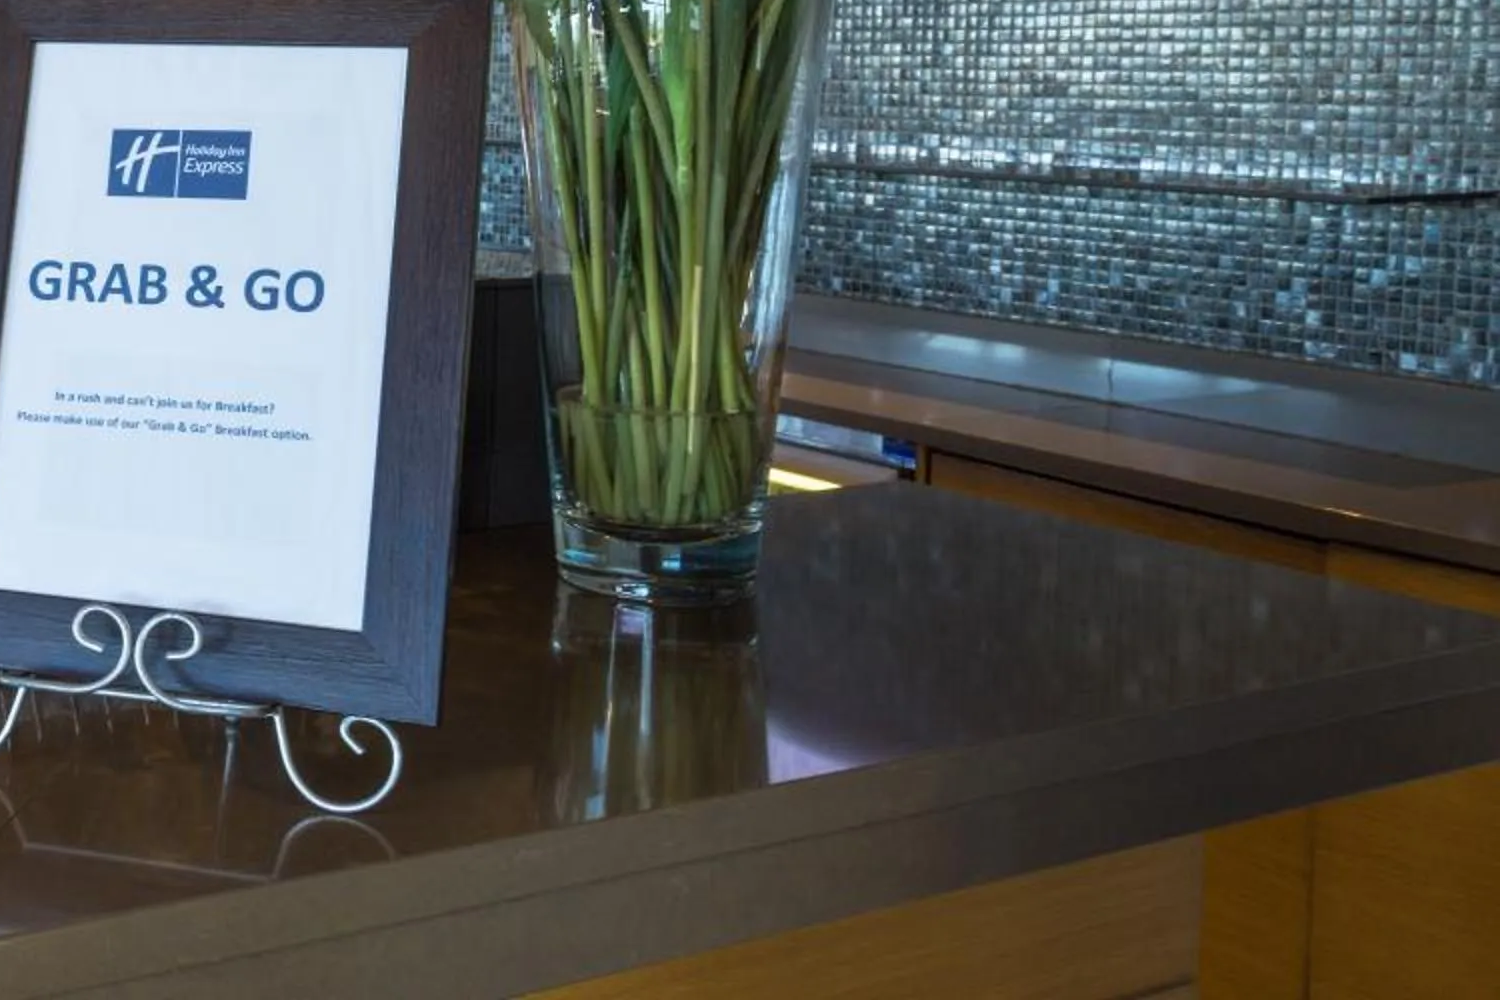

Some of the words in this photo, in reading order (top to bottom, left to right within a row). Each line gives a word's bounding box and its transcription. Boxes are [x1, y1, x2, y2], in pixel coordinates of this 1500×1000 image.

[185, 143, 227, 159] Holiday
[227, 145, 245, 157] Inn
[183, 157, 245, 177] Express
[29, 259, 168, 305] GRAB
[184, 264, 226, 309] &
[243, 268, 326, 313] GO
[54, 391, 65, 401] In
[67, 393, 75, 401] a
[77, 392, 101, 403] rush
[104, 394, 125, 404] and
[127, 394, 155, 407] can't
[156, 396, 178, 409] join
[180, 400, 193, 409] us
[196, 399, 212, 410] for
[215, 400, 275, 415] Breakfast?
[16, 410, 50, 422] Please
[53, 413, 82, 425] make
[85, 417, 104, 427] use
[106, 416, 119, 427] of
[121, 419, 140, 429] our
[177, 421, 187, 433] &
[215, 424, 268, 438] Breakfast
[271, 429, 311, 441] option.
